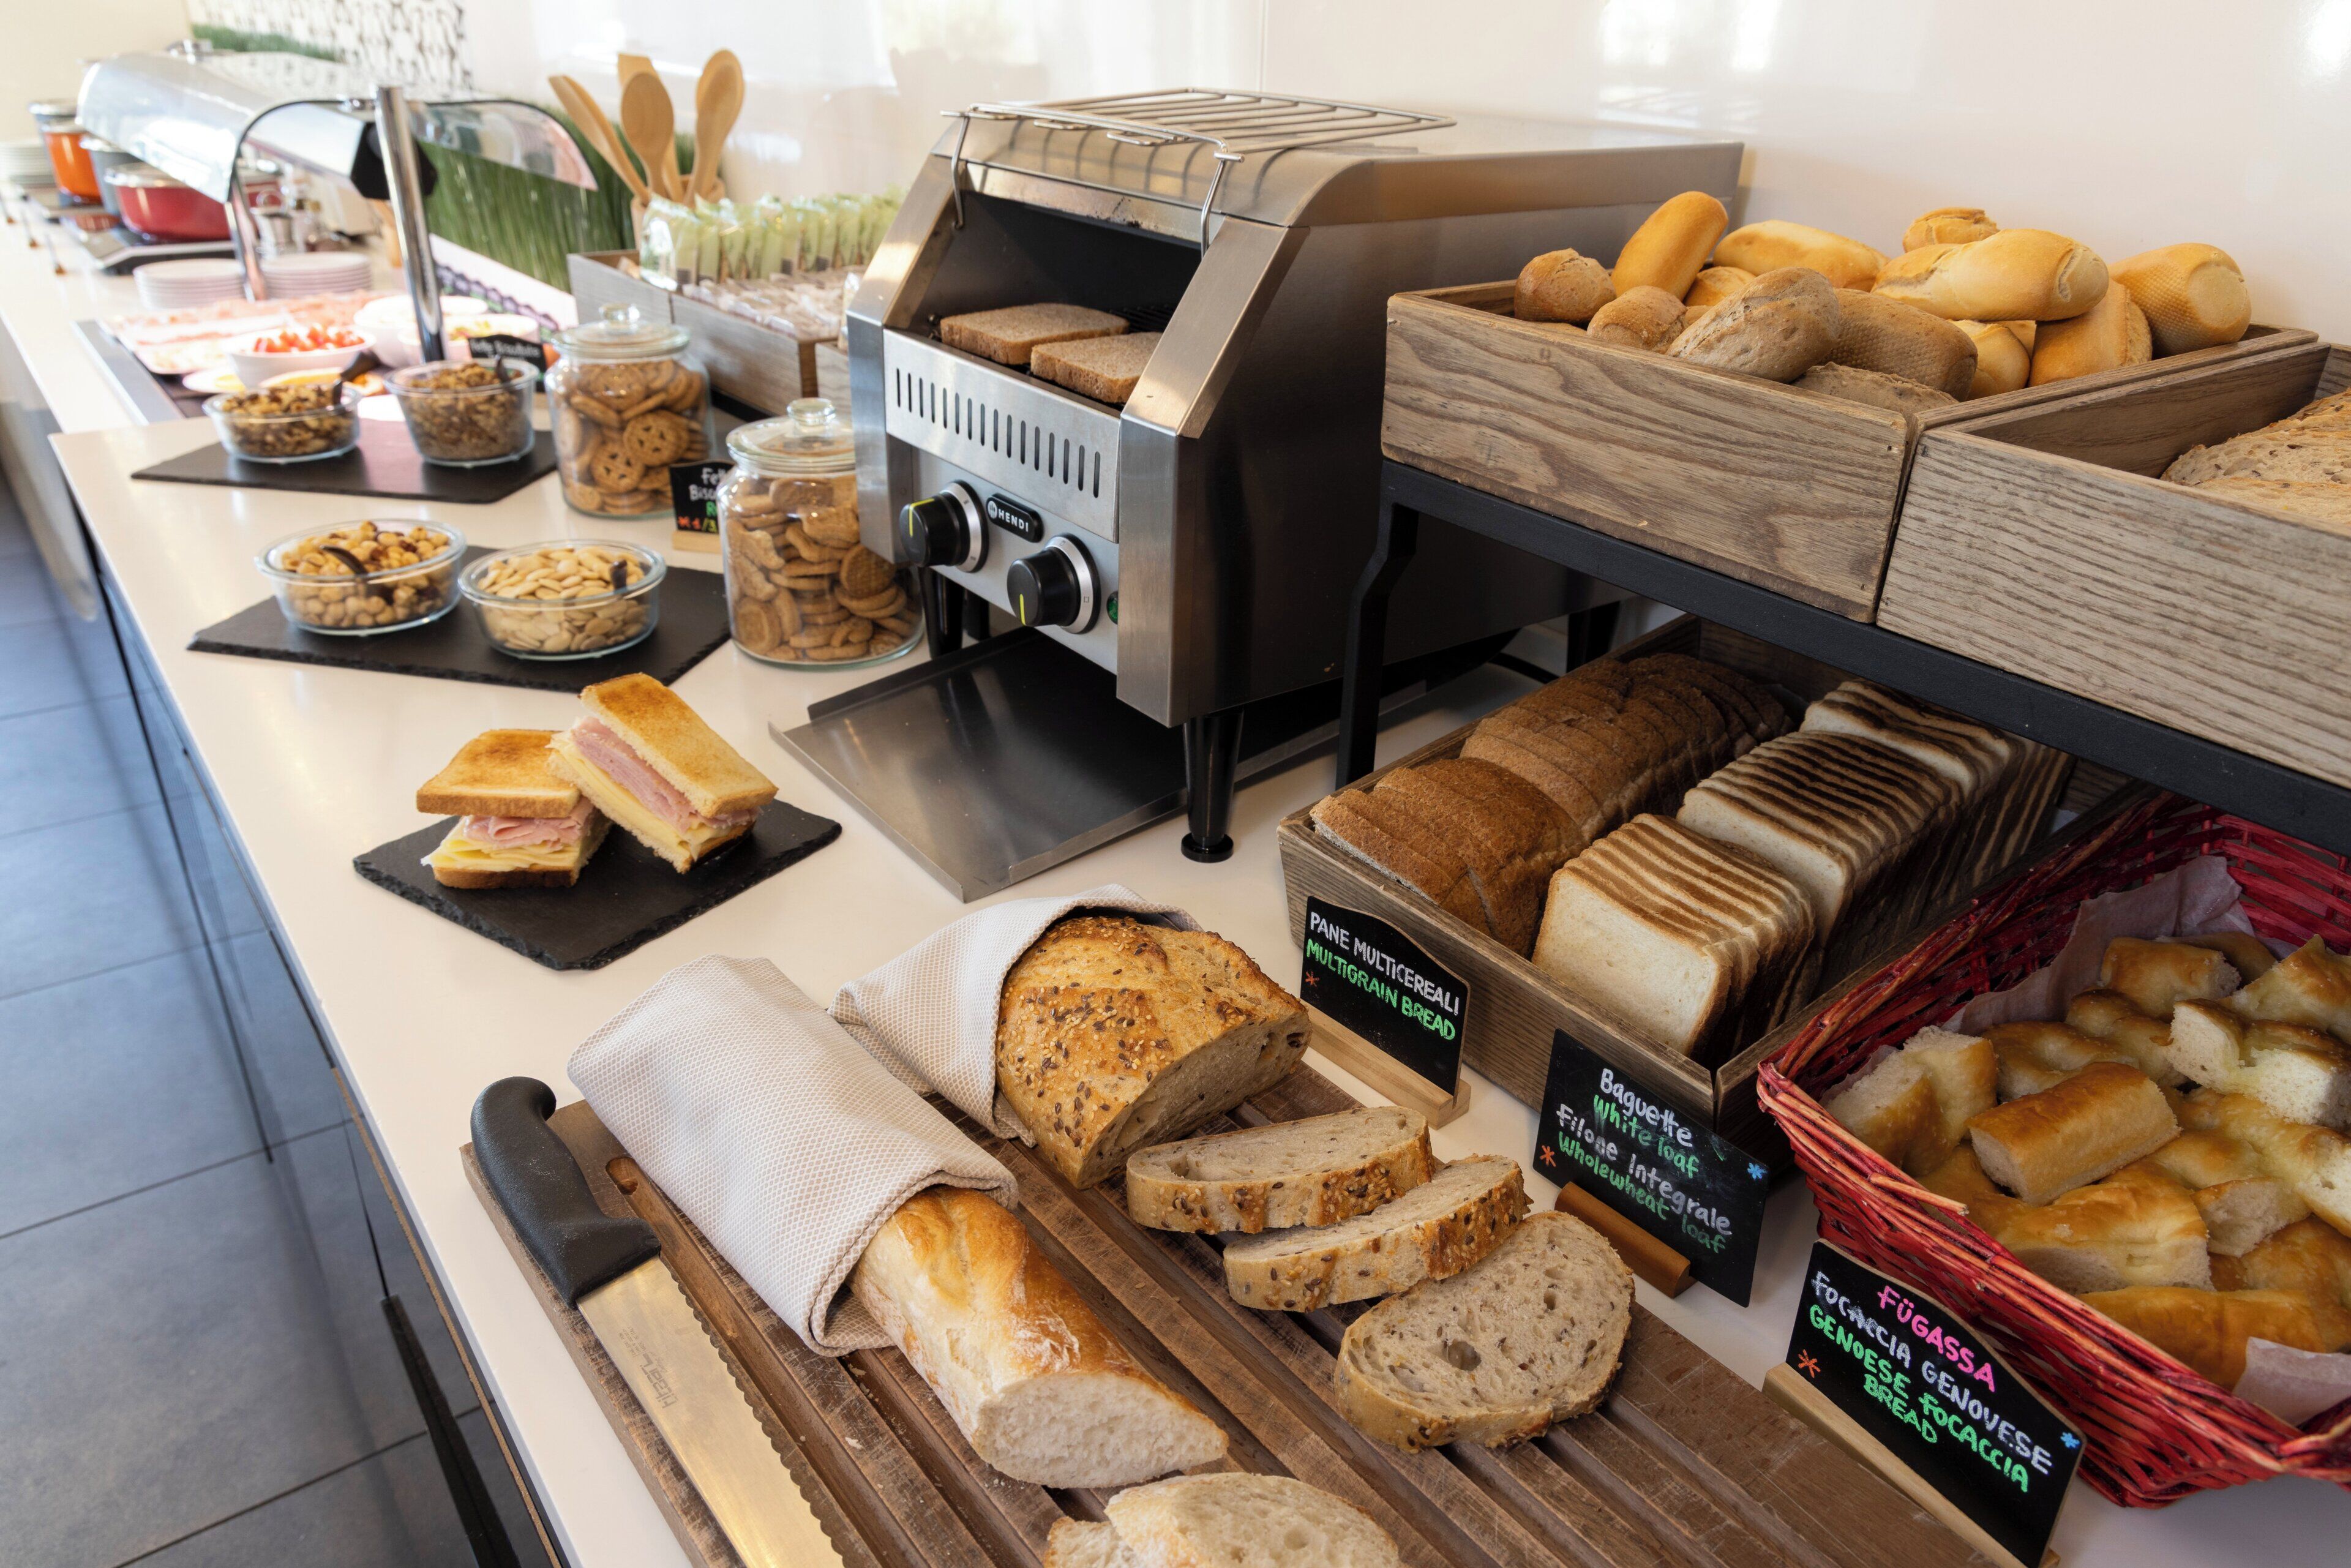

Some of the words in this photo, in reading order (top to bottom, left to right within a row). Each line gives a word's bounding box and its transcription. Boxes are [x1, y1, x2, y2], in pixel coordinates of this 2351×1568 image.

[999, 509, 1029, 532] HENDI
[1307, 939, 1398, 1008] MULTIGRAIN
[1401, 996, 1455, 1040] BREAD
[1310, 912, 1349, 950] PANE
[1354, 937, 1460, 1015] MULTICEREALI
[1593, 1094, 1652, 1146] White
[1657, 1136, 1700, 1179] loaf
[1600, 1068, 1693, 1147] Baguette
[1556, 1103, 1619, 1161] Filone
[1629, 1153, 1733, 1235] Integrale
[1559, 1131, 1670, 1220] Wholewheat
[1682, 1214, 1726, 1253] loaf
[1811, 1270, 1911, 1368] FOCACCIA
[1921, 1360, 2053, 1475] GENOVESE
[1877, 1286, 1995, 1393] FÜGASSA
[1810, 1304, 1911, 1399] GENOESE
[1918, 1392, 2028, 1493] FOCACCIA
[1863, 1374, 1938, 1443] BREAD
